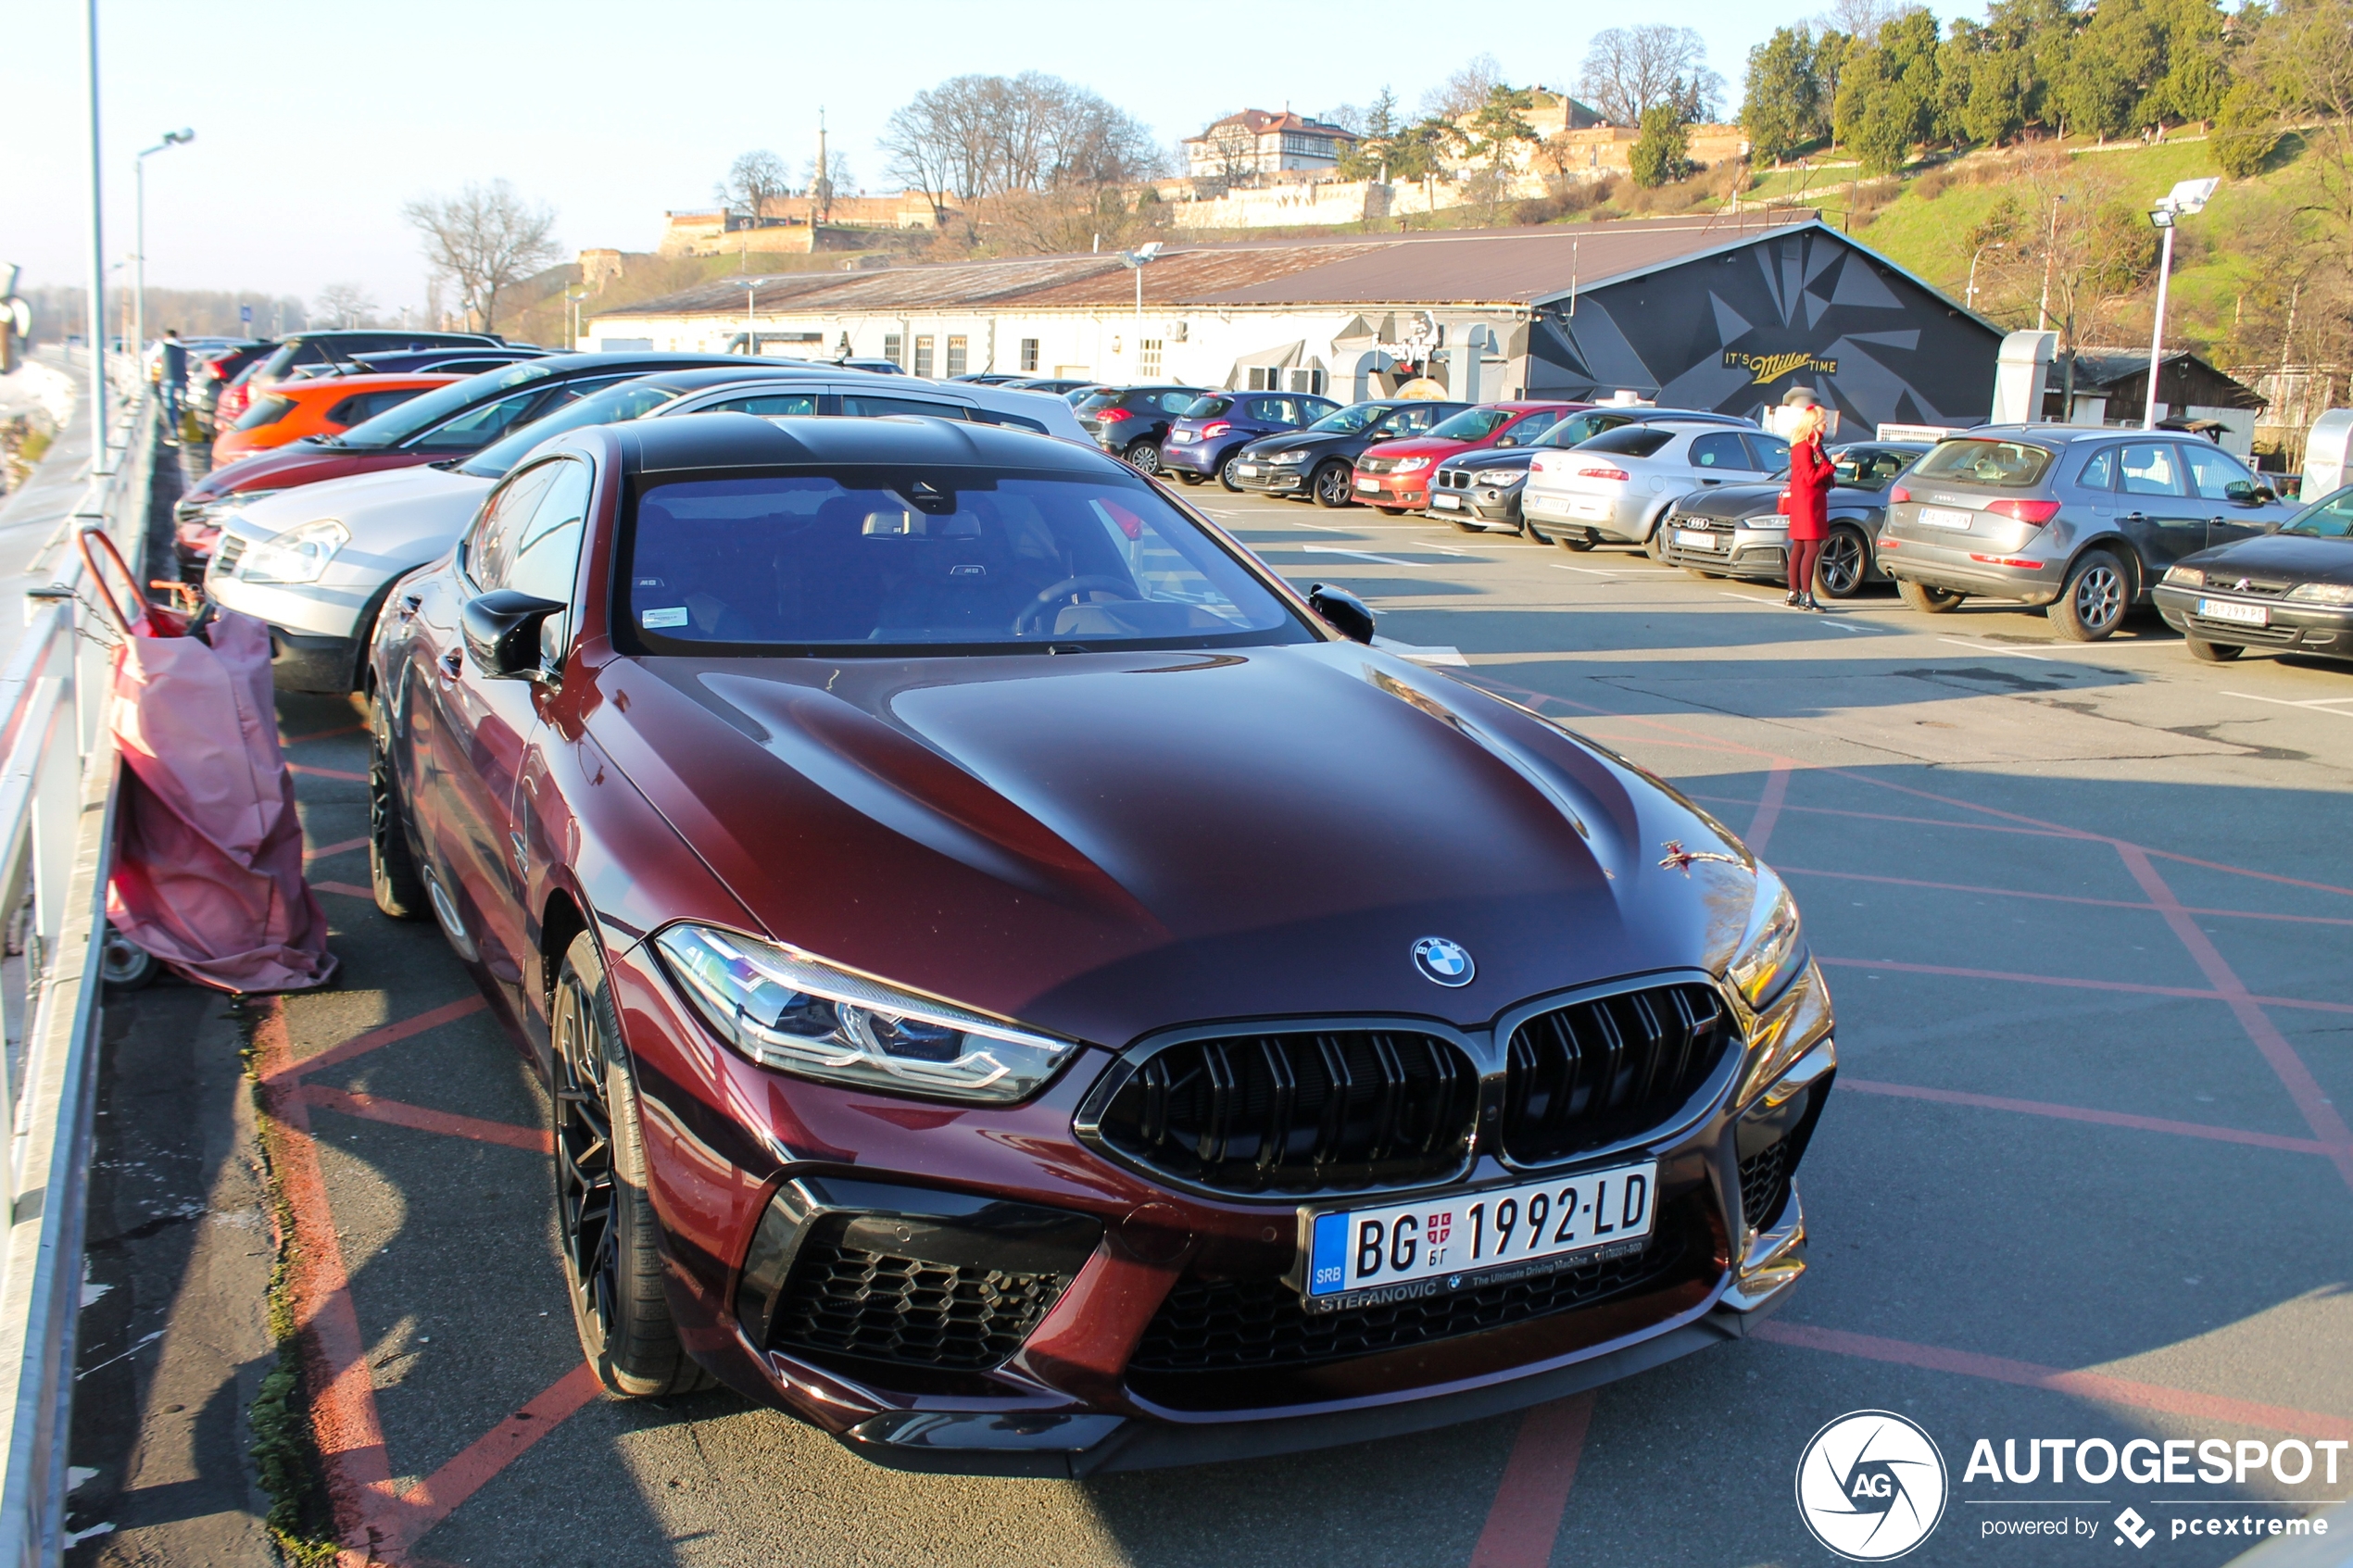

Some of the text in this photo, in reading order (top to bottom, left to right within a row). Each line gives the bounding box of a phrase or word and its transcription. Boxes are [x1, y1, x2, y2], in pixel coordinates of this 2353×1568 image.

[1371, 332, 1434, 366] freestyler
[1725, 352, 1837, 384] IT'S Miller TIME
[2207, 601, 2219, 615] BG
[2227, 606, 2246, 618] 299
[1416, 938, 1462, 955] BMW
[1355, 1214, 1419, 1279] BG
[1316, 1266, 1341, 1285] SRB
[1319, 1278, 1437, 1312] STEFANOVIĆ
[1473, 1275, 1489, 1286] The
[1491, 1269, 1525, 1284] Ultimate
[1526, 1262, 1554, 1277] Driving
[1554, 1256, 1588, 1270] Machine
